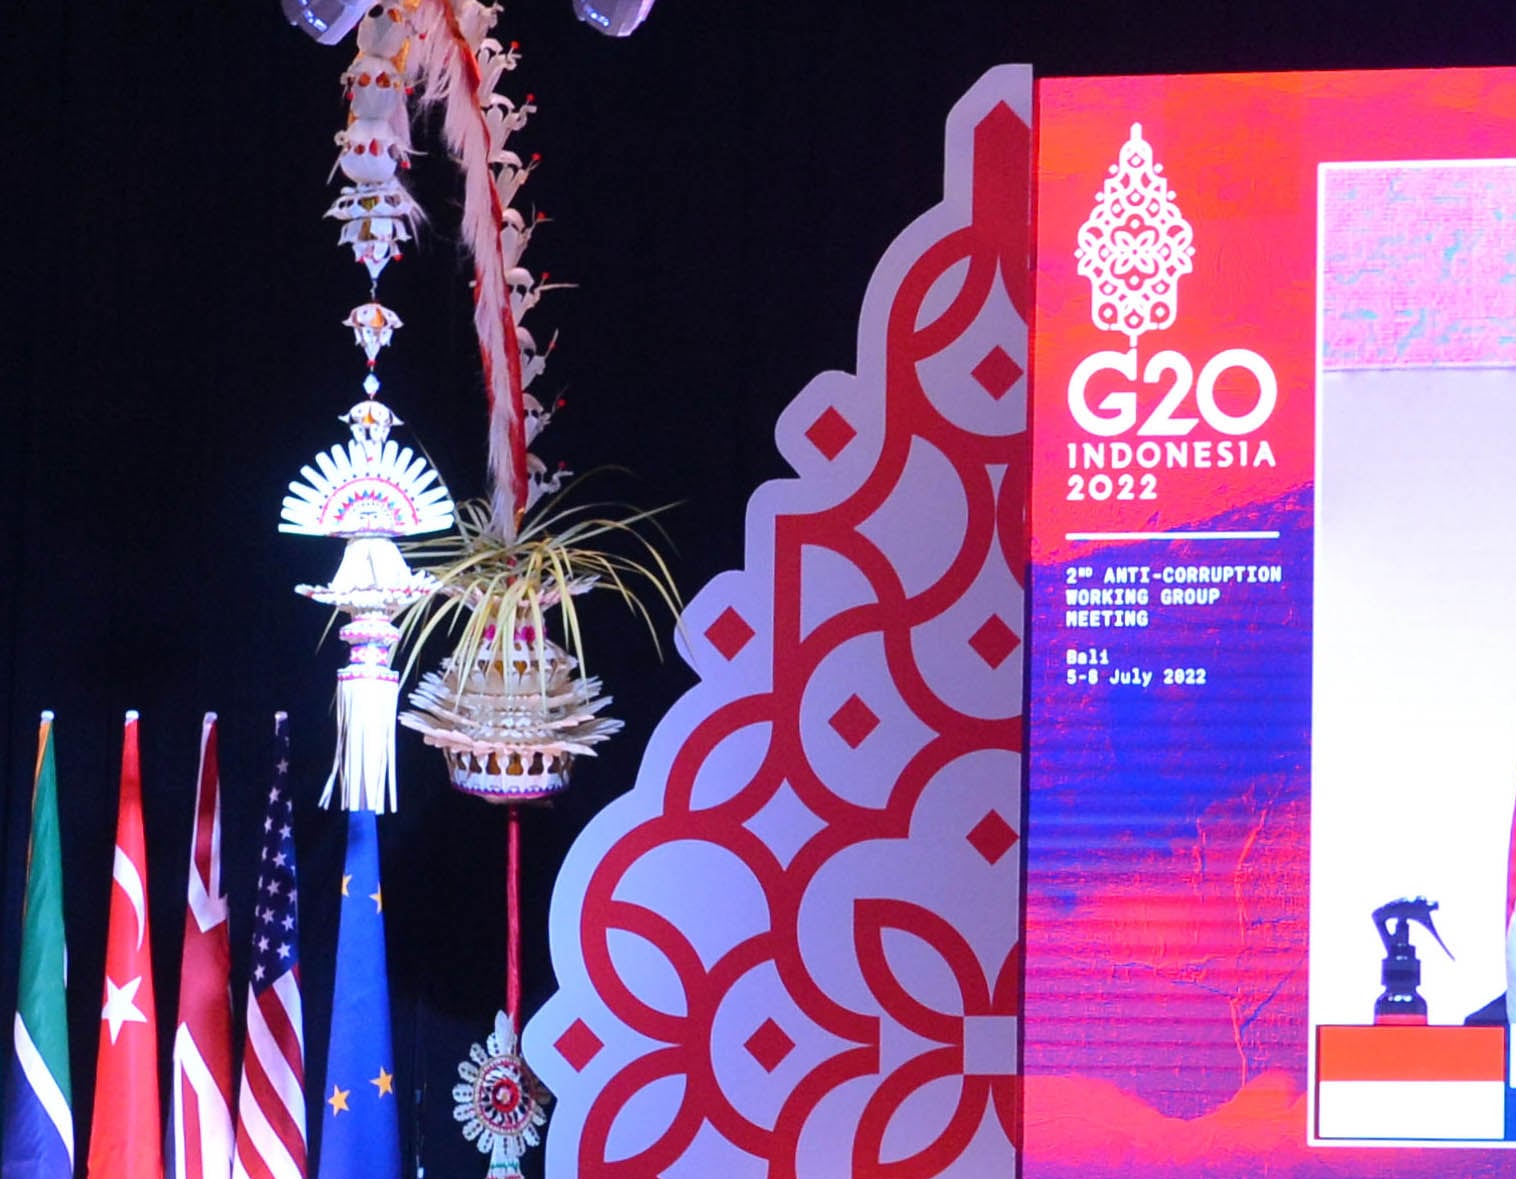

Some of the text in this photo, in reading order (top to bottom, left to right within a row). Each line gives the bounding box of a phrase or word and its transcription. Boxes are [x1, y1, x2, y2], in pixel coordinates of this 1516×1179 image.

[1067, 348, 1277, 436] G20
[1067, 440, 1276, 469] INDONESIA
[1067, 474, 1158, 500] 2022
[1104, 565, 1282, 583] ANTI-CORRUPTION
[1065, 588, 1221, 606] WORKING GROUP
[1065, 610, 1149, 627] MEETING
[1066, 648, 1109, 664] Bali
[1109, 668, 1152, 687] July
[1163, 668, 1207, 684] 2022
